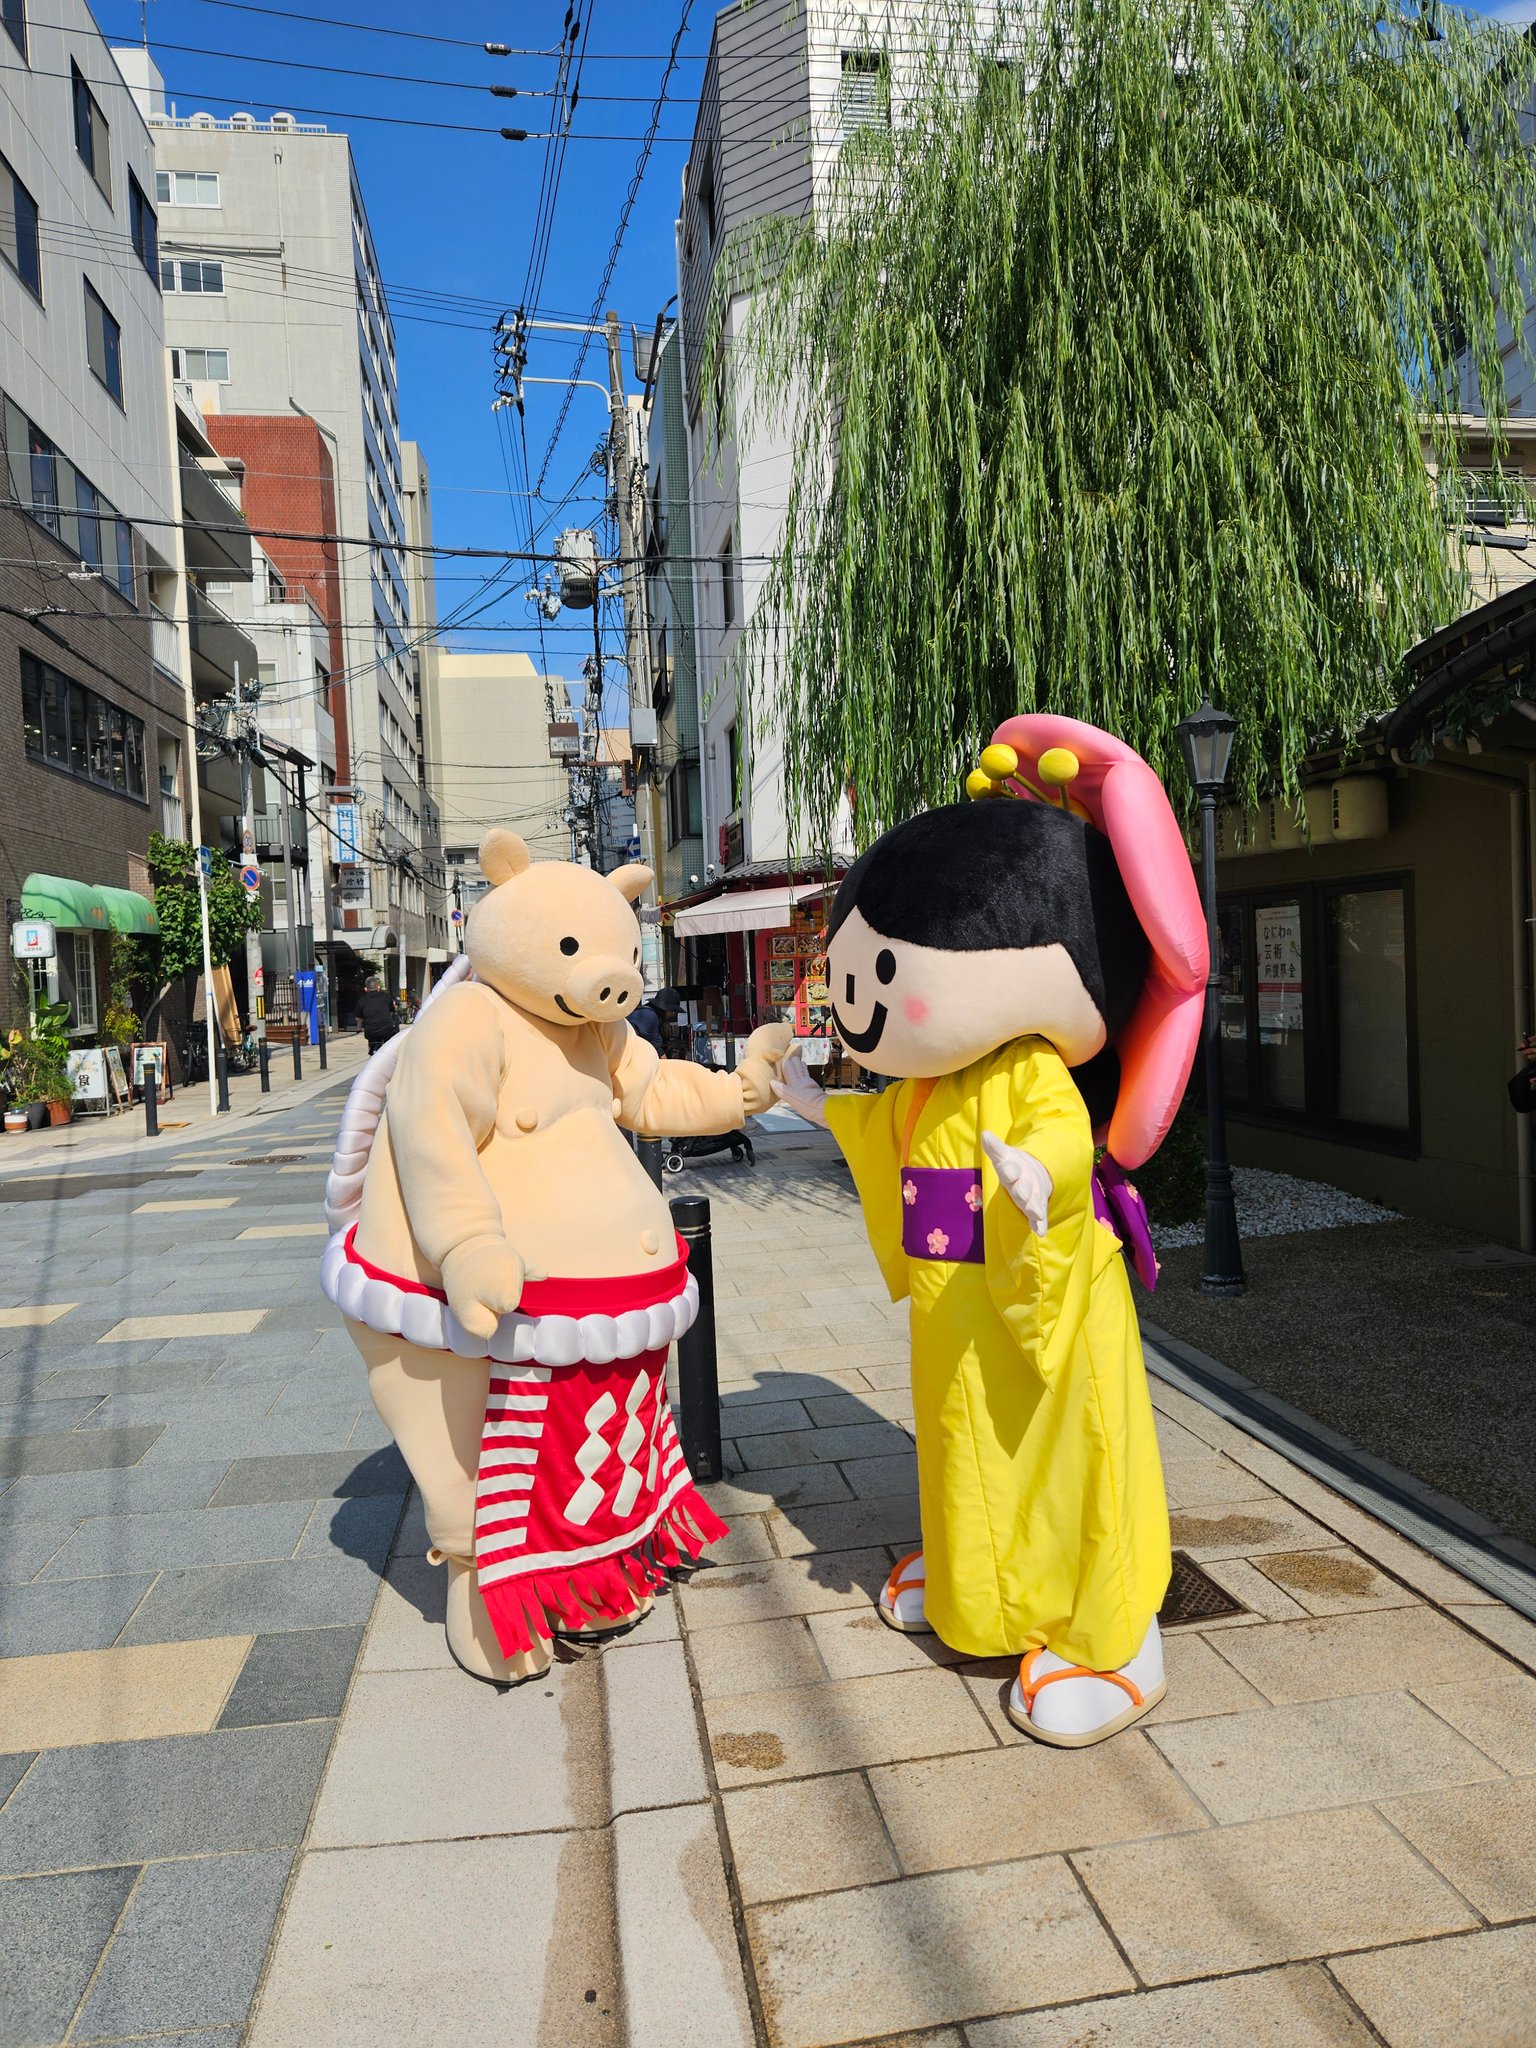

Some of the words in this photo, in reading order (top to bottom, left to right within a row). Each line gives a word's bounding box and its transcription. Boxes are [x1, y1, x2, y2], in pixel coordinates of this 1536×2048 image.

[1263, 925, 1292, 940] なにわの
[1264, 943, 1282, 960] 芸術
[1264, 963, 1297, 978] 応援募金
